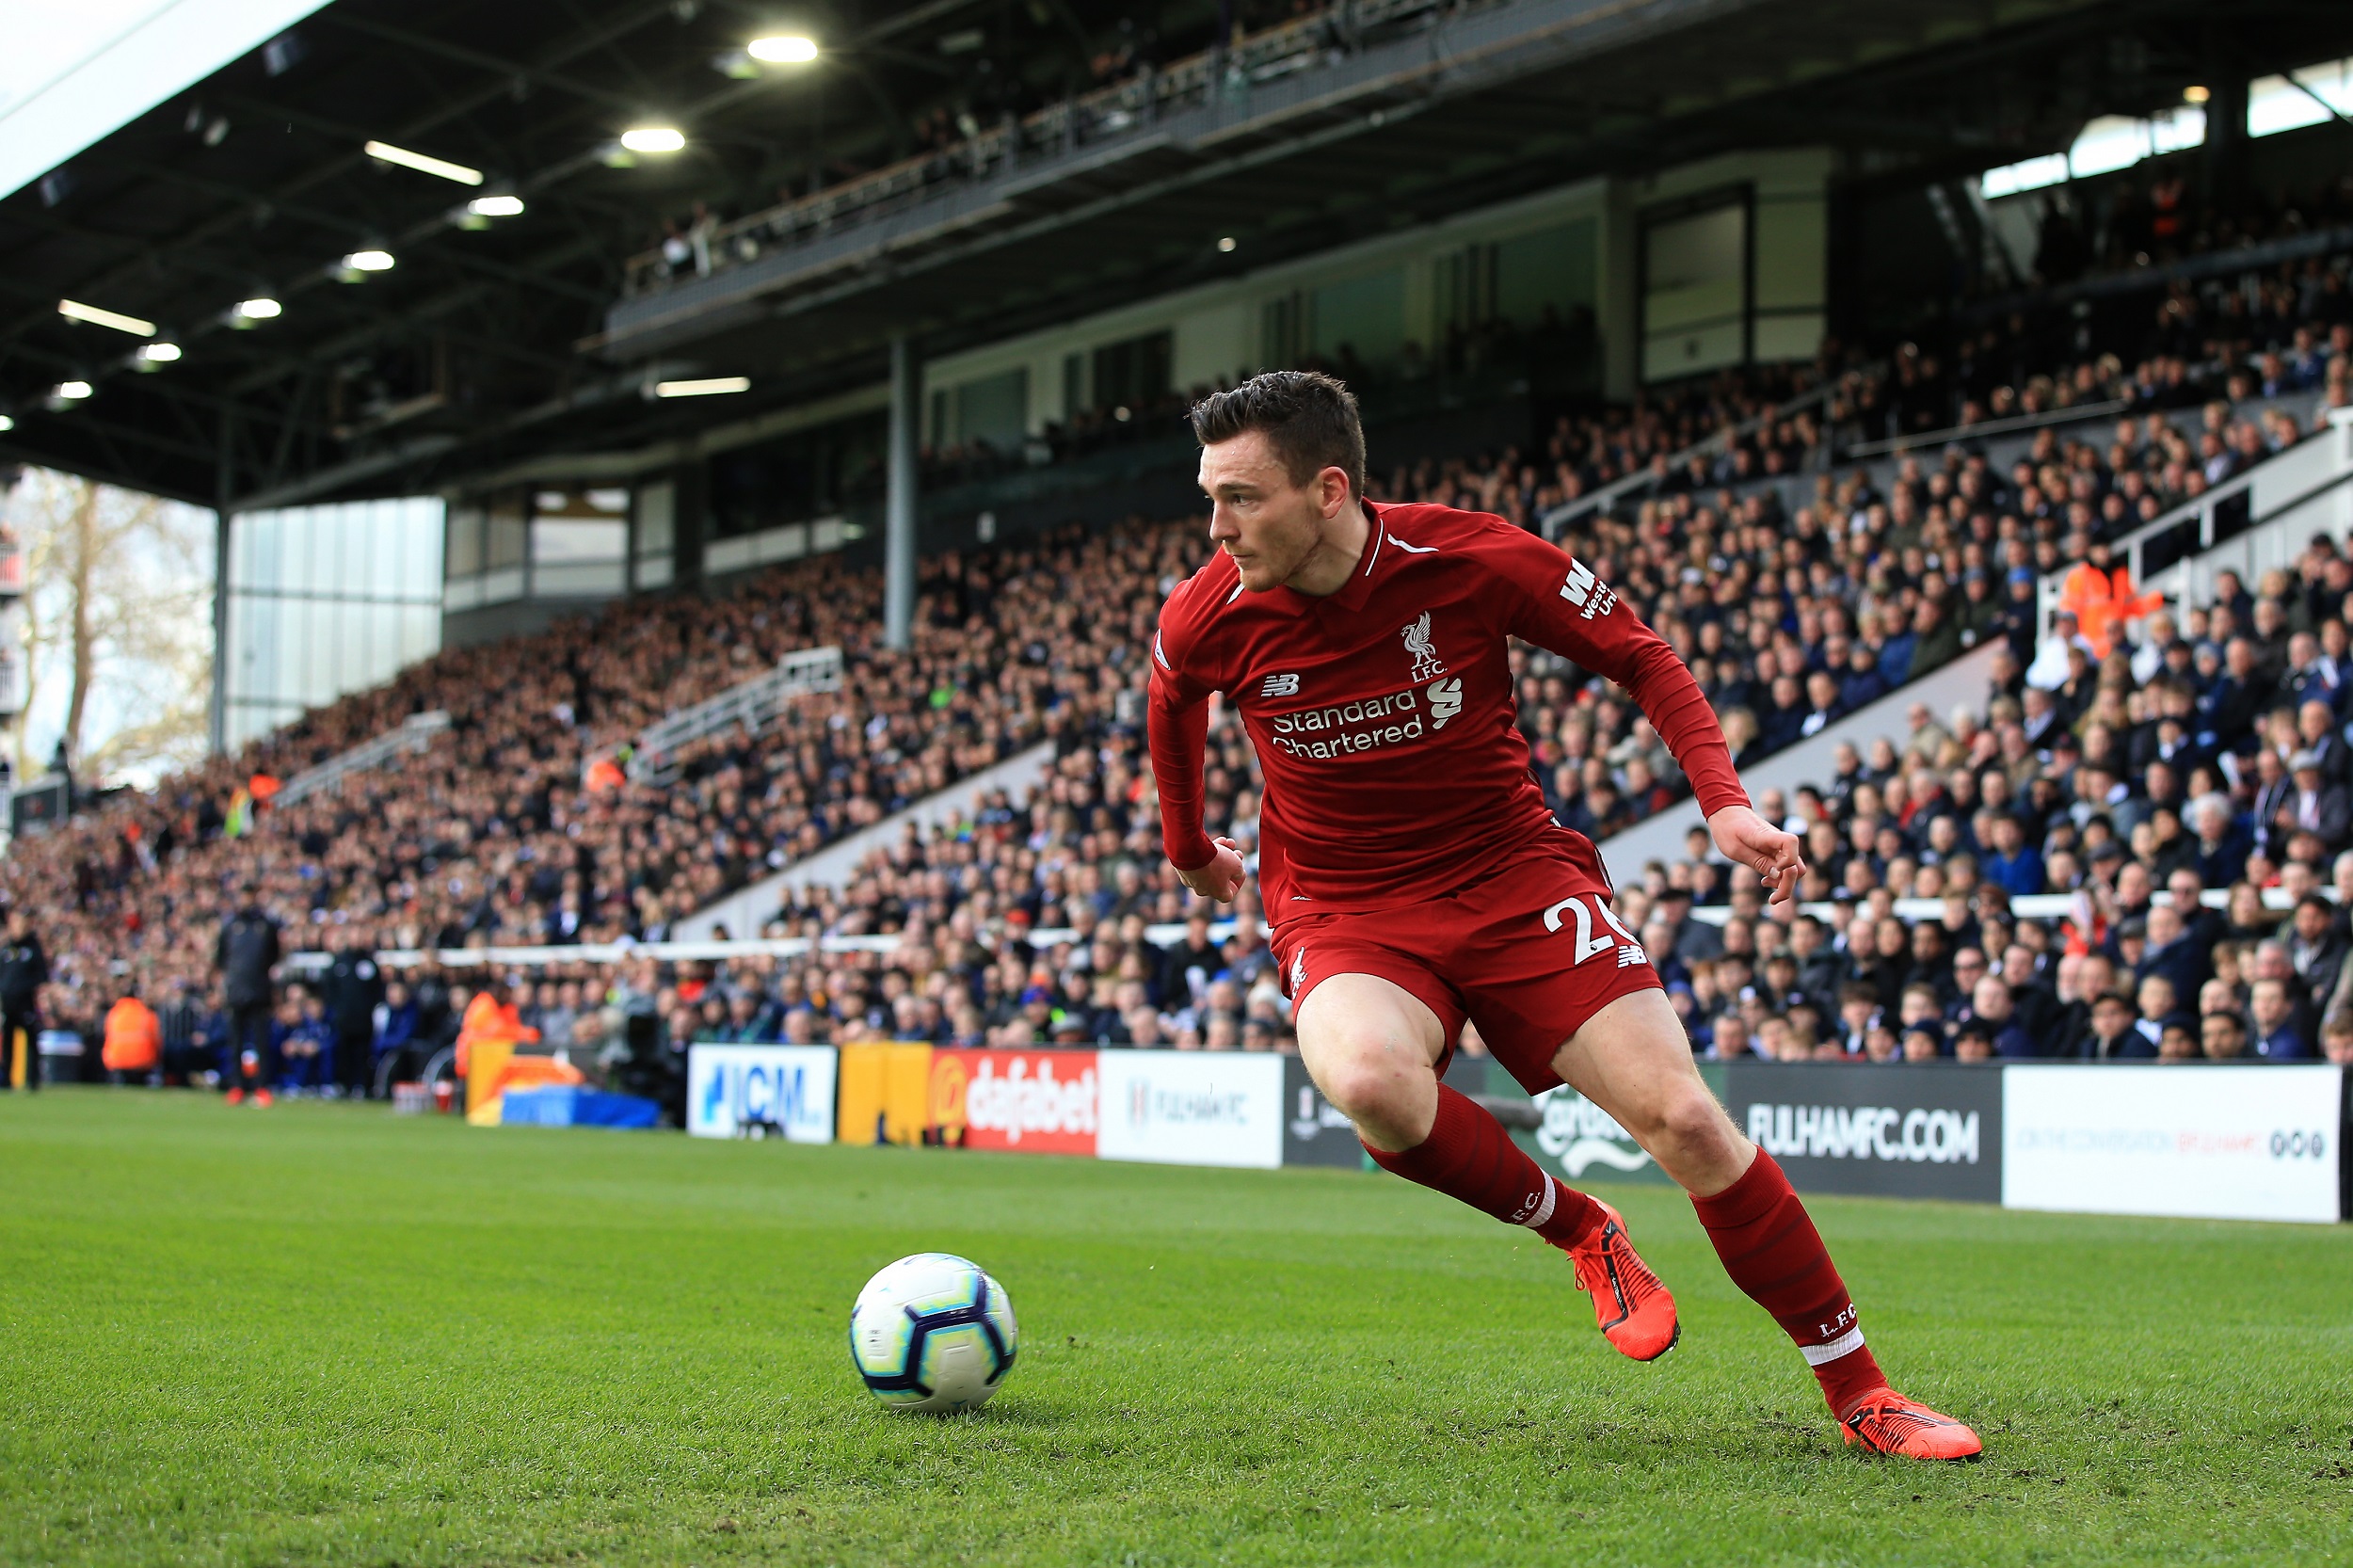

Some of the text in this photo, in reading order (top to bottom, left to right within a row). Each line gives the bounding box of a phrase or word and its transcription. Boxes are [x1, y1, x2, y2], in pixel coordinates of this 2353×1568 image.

[1579, 580, 1608, 620] Weste
[1598, 587, 1619, 616] Uni
[1412, 661, 1448, 683] L.F.C.
[1273, 690, 1417, 733] Standard
[1273, 713, 1423, 759] Chartered
[966, 1055, 1096, 1145] dafabet
[1748, 1102, 1979, 1165] FULHAMFC.COM
